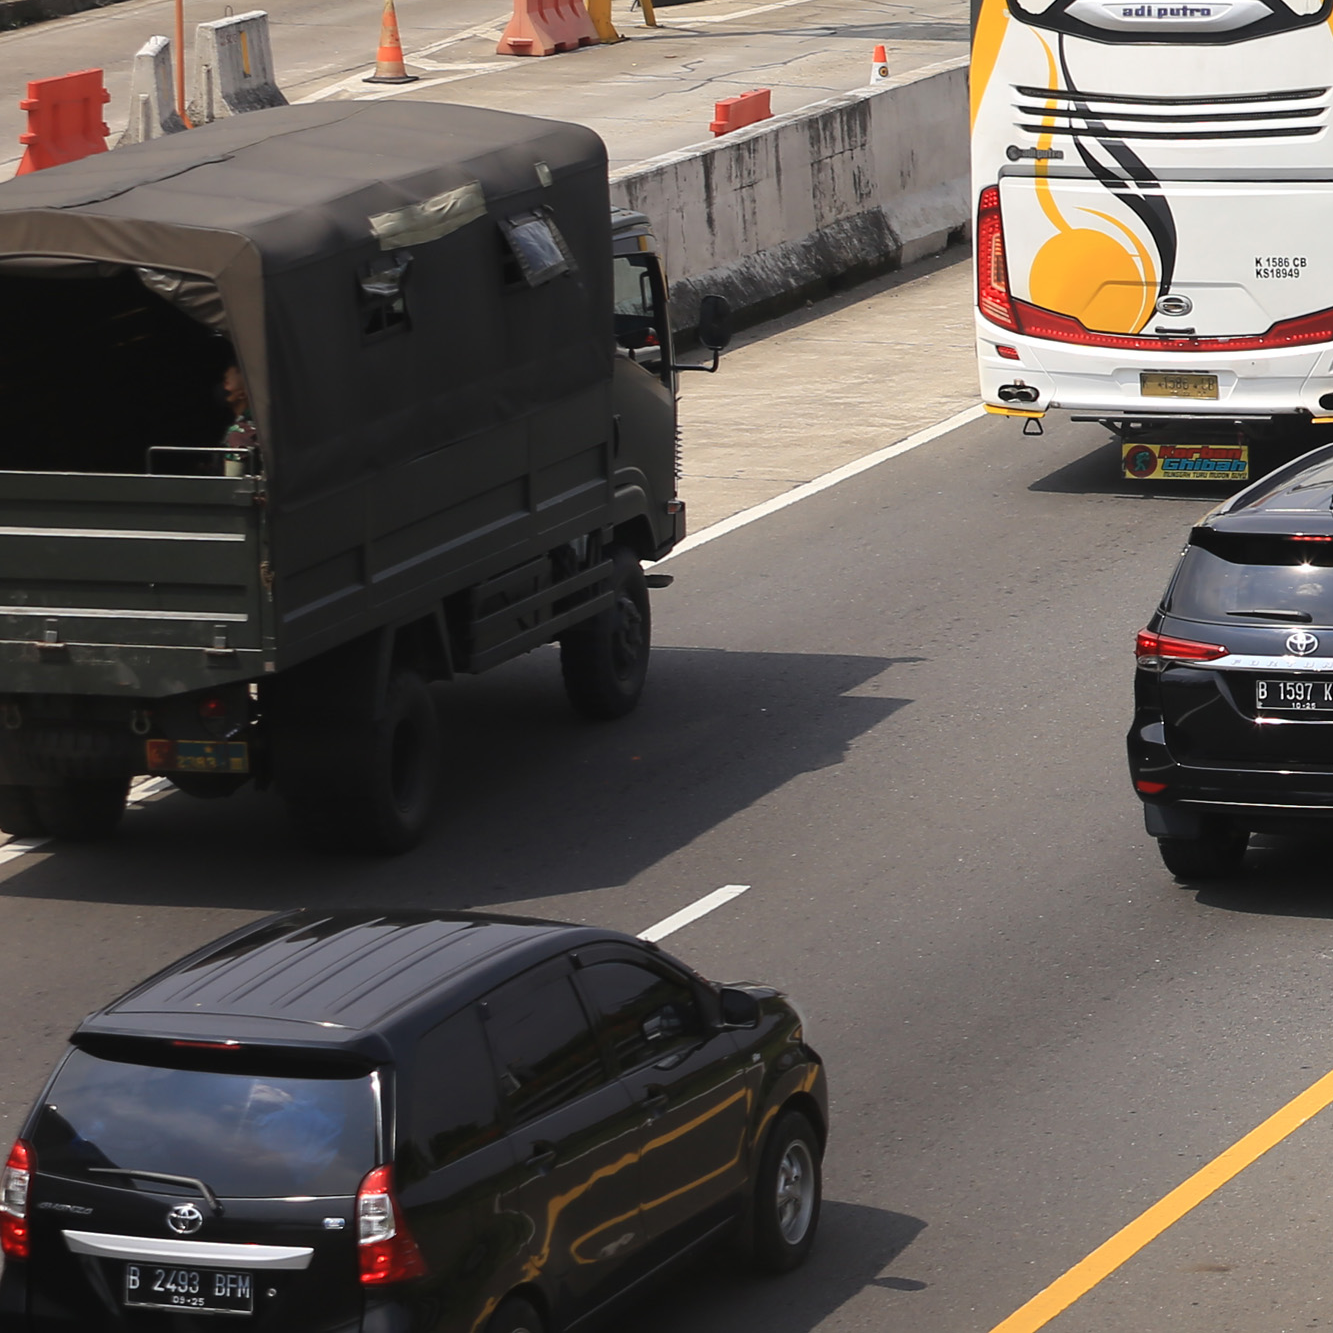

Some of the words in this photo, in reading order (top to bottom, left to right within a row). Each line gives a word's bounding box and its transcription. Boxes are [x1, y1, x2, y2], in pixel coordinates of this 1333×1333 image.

[1122, 5, 1152, 17] adi
[1157, 5, 1212, 19] putro
[1255, 257, 1263, 267] K
[1265, 257, 1290, 268] 1586
[1292, 257, 1307, 268] CB
[1255, 268, 1300, 278] KS18949
[1158, 445, 1243, 460] Korban
[1161, 457, 1248, 472] Ghibah
[1258, 682, 1268, 700] B
[1279, 682, 1313, 701] 1597
[128, 1266, 140, 1290] B
[153, 1269, 201, 1295] 2493
[213, 1273, 250, 1299] BFM
